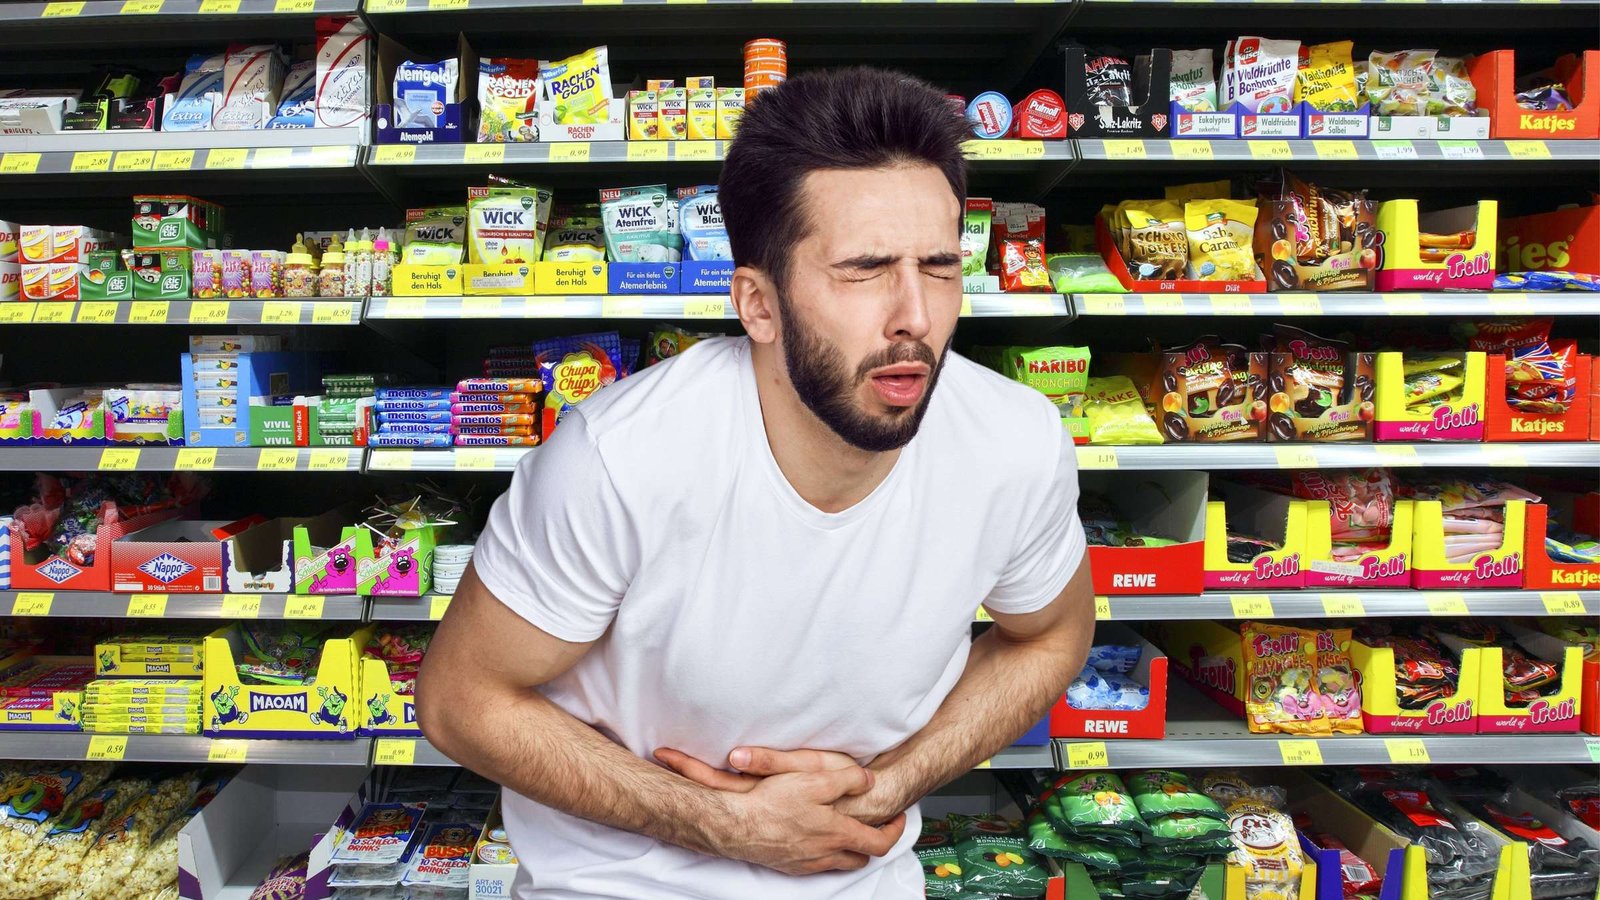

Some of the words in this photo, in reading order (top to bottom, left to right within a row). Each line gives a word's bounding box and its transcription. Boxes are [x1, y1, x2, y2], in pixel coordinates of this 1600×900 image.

[1237, 58, 1292, 82] Waldfrüchte
[488, 74, 537, 90] RACHEN
[550, 65, 600, 95] RACHEN
[561, 77, 596, 100] GOLD
[1238, 77, 1278, 96] Bonbons
[493, 85, 530, 98] GOLD
[1029, 100, 1061, 116] Pulmoll
[170, 112, 204, 121] Extra
[220, 112, 255, 121] Extra
[1198, 116, 1231, 125] Eukalyptus
[1261, 118, 1297, 127] Waldfrüchte
[1328, 117, 1363, 127] Waldhonig-
[1519, 115, 1575, 133] Katjes
[1328, 126, 1347, 134] Salbei
[400, 130, 434, 143] Atemgold
[572, 131, 592, 139] GOLD
[91, 158, 109, 166] 2.89
[133, 158, 151, 166] 2.89
[173, 157, 191, 165] 1.49
[470, 189, 490, 197] NEU
[602, 190, 621, 199] NEU
[679, 188, 698, 196] NEU
[618, 206, 652, 219] WICK
[483, 211, 525, 225] WICK
[615, 217, 657, 228] Atemfrei
[702, 216, 724, 225] Blau
[163, 224, 178, 233] tic
[162, 230, 178, 238] tac
[417, 228, 455, 240] WICK
[558, 231, 597, 243] WICK
[193, 260, 212, 273] Hit
[222, 260, 240, 273] Hit
[252, 261, 271, 273] Hit
[1445, 251, 1490, 279] Trolli
[411, 272, 442, 281] Beruhigt
[556, 269, 587, 278] Beruhigt
[626, 271, 637, 279] Für
[645, 271, 661, 279] tiefes
[700, 268, 710, 276] Für
[111, 277, 126, 286] tic
[166, 276, 180, 286] tic
[556, 278, 570, 286] den
[571, 277, 588, 286] Hals
[1413, 270, 1434, 281] world
[1434, 271, 1443, 284] of
[110, 282, 125, 291] tac
[164, 282, 180, 291] tac
[411, 281, 425, 289] den
[427, 281, 442, 290] Hals
[619, 280, 668, 290] Atemerlebnis
[1160, 281, 1176, 290] Diät
[1225, 284, 1240, 292] Diät
[704, 304, 722, 312] 1.59
[333, 309, 350, 317] 0.59
[1289, 340, 1342, 361] Trolli
[1028, 358, 1087, 374] HARIBO
[560, 365, 597, 378] Chupa
[467, 383, 509, 392] mentos
[558, 376, 597, 398] Chups
[1028, 377, 1085, 389] BRONCHIOL
[387, 389, 428, 398] mentos
[458, 393, 499, 402] mentos
[383, 400, 425, 409] mentos
[462, 403, 505, 413] mentos
[387, 411, 427, 420] mentos
[460, 415, 502, 425] mentos
[1432, 403, 1480, 431] Trolli
[263, 420, 292, 429] VIVIL
[390, 423, 430, 432] mentos
[1399, 423, 1420, 433] world
[1420, 424, 1430, 435] of
[1511, 418, 1565, 435] Katjes
[459, 425, 500, 434] mentos
[264, 437, 292, 445] VIVIL
[323, 437, 351, 445] VIVIL
[378, 436, 420, 445] mentos
[466, 437, 508, 446] mentos
[153, 563, 183, 576] Nappo
[1253, 553, 1300, 580] Trolli
[1358, 553, 1406, 580] Trolli
[1473, 552, 1520, 580] Trolli
[49, 565, 70, 578] Nappo
[1112, 573, 1157, 588] REWE
[1219, 572, 1241, 583] world
[1241, 573, 1250, 585] of
[1440, 571, 1461, 582] world
[1462, 572, 1471, 584] of
[1551, 569, 1600, 587] Katjes
[1252, 632, 1300, 657] Trolli
[147, 664, 170, 673] MAOAM
[252, 695, 305, 711] MAOAM
[1425, 699, 1473, 725] Trolli
[1529, 697, 1576, 724] Trolli
[1391, 717, 1411, 727] world
[1496, 716, 1516, 727] world
[1517, 718, 1526, 729] of
[1084, 720, 1128, 734] REWE
[106, 745, 123, 753] 0.59
[1409, 748, 1425, 757] 1.19
[1088, 751, 1105, 760] 0.99
[362, 838, 402, 846] SCHLECK-
[347, 844, 380, 852] DRINKS
[419, 858, 430, 866] 10
[430, 859, 471, 869] SCHLECK-
[417, 865, 451, 874] DRINKS
[475, 879, 504, 887] ART.-NR.
[475, 885, 502, 894] 30021
